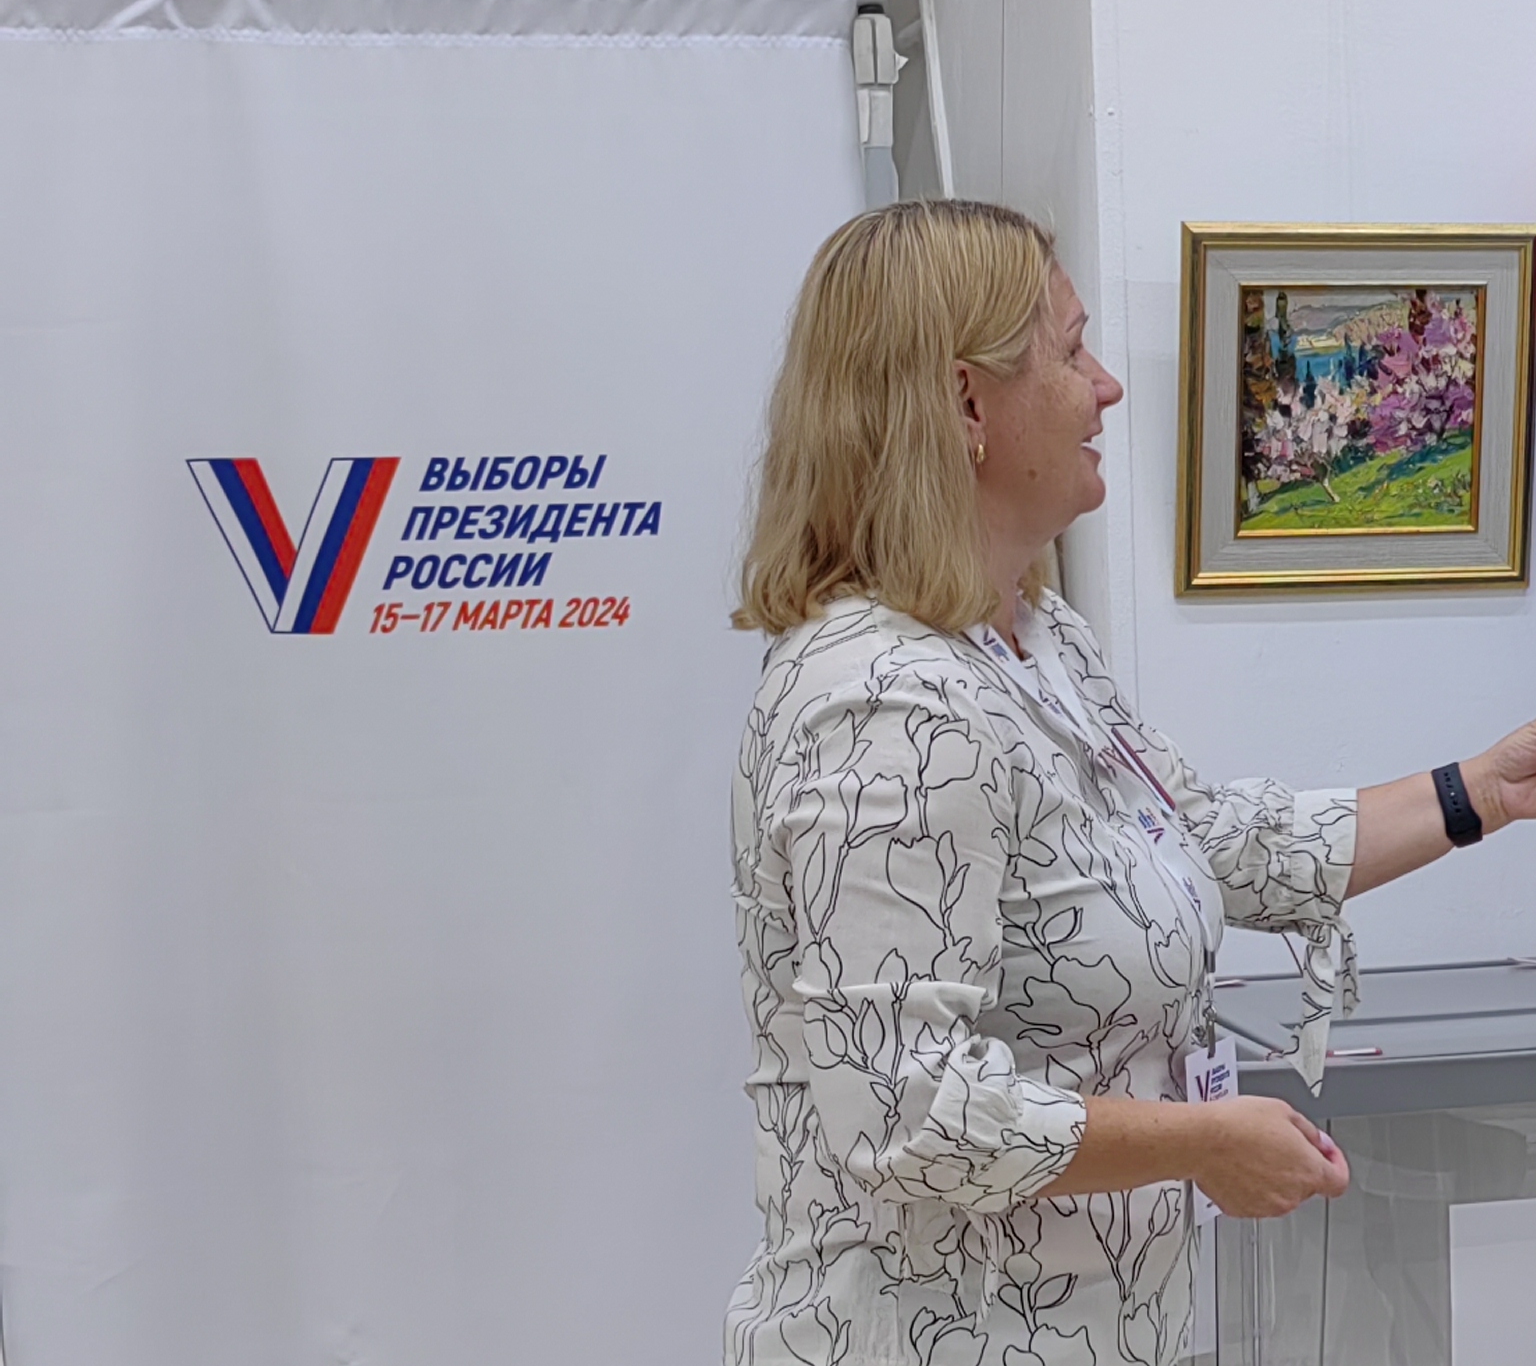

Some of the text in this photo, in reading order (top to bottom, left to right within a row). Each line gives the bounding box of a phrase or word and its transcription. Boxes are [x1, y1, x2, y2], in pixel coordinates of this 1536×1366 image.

[419, 454, 608, 492] ВЫБОРЫ
[400, 501, 663, 544] ПРЕЗИДЕНТА
[382, 551, 553, 590] РОССИИ
[452, 598, 555, 632] МАРТА
[557, 596, 630, 629] 2024
